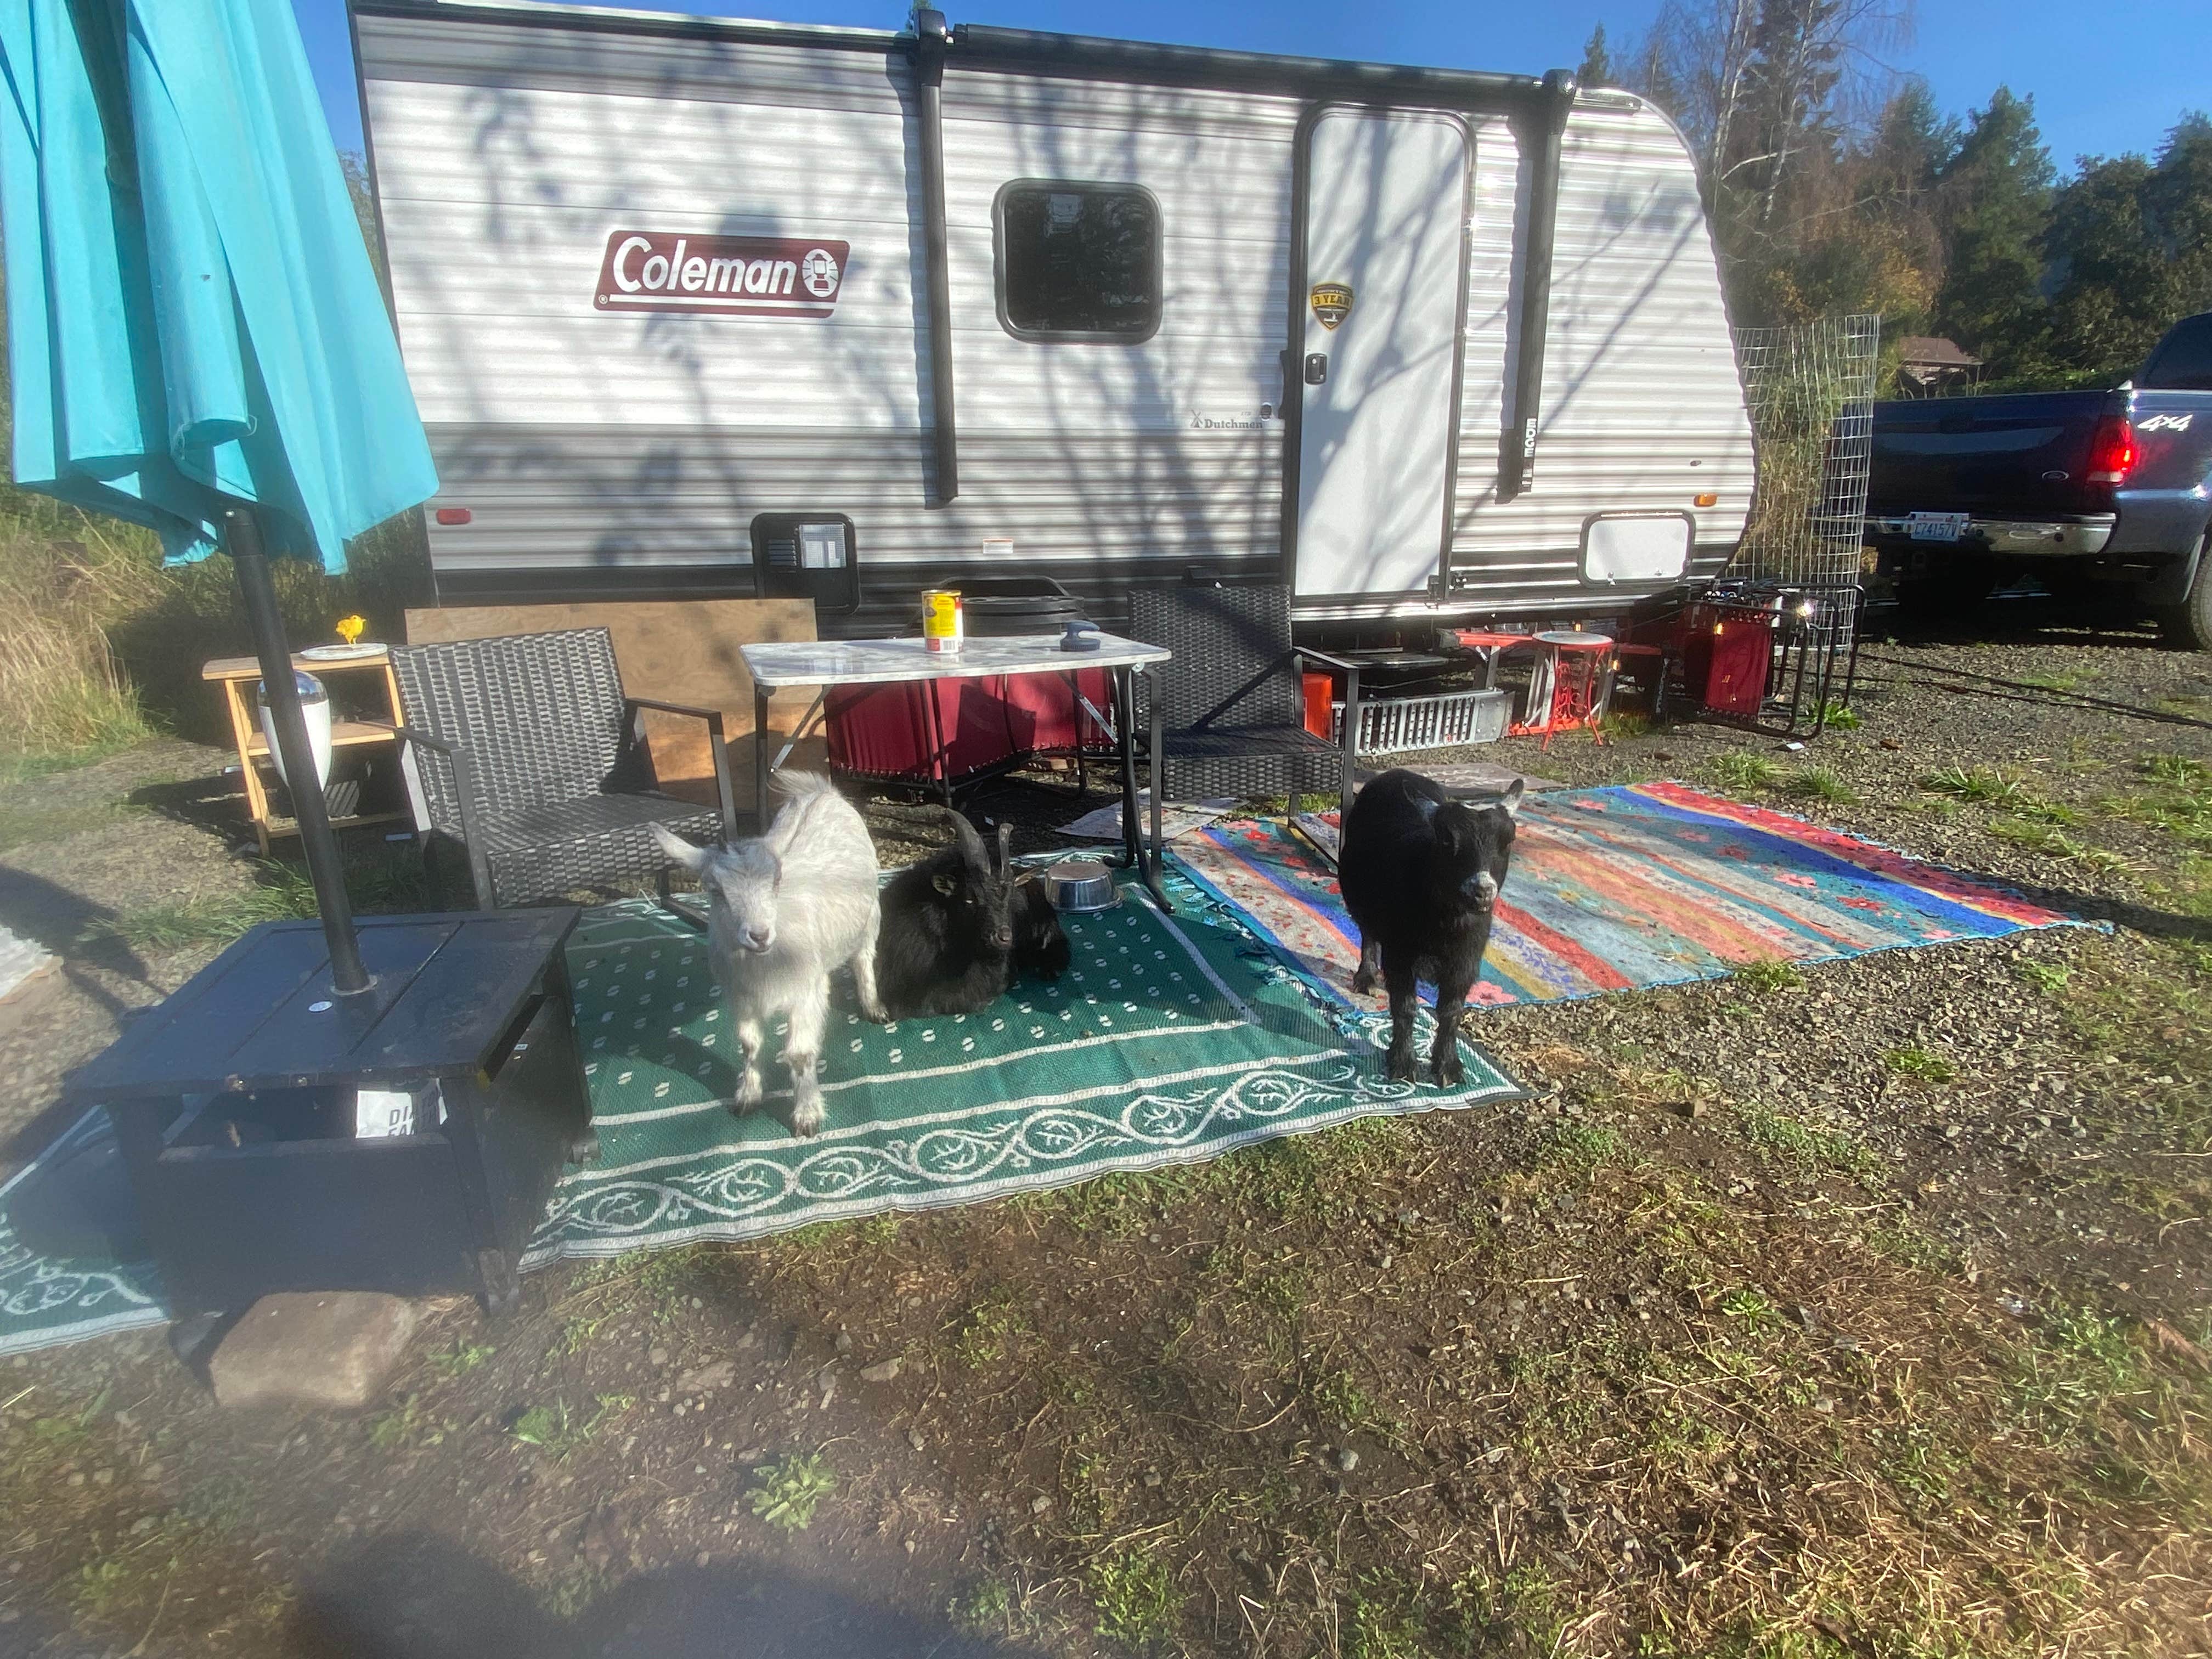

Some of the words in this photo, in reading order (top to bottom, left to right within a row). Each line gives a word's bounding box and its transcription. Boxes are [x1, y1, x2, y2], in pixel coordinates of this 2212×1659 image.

[613, 236, 797, 294] Coleman
[1323, 295, 1350, 307] YEAR
[1204, 419, 1262, 428] Dutchmen
[1524, 418, 1537, 458] EDGE
